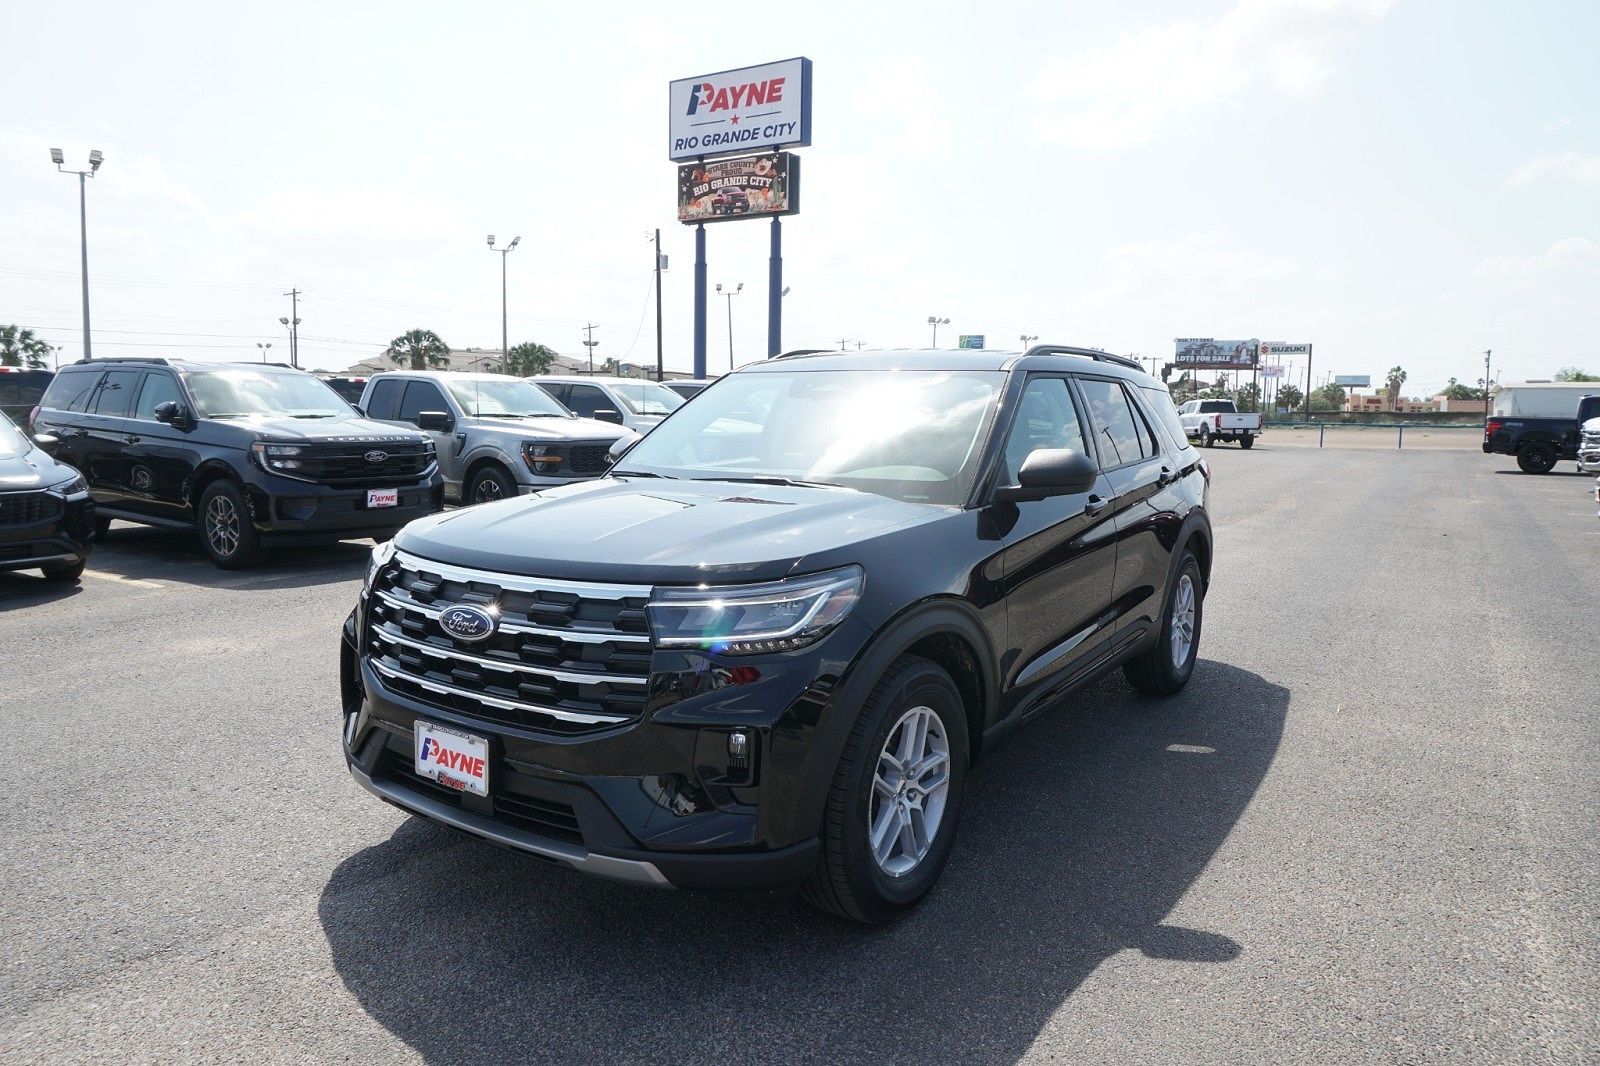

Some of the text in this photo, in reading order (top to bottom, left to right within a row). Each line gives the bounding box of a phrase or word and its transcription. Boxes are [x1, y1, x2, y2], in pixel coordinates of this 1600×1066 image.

[686, 77, 786, 116] PAYNE
[674, 121, 797, 151] RIO GRANDE CITY
[729, 160, 756, 169] COUNTY
[693, 176, 772, 196] RIO GRANDE CITY
[369, 495, 396, 503] PAYNE
[449, 611, 478, 633] Ford
[420, 737, 486, 779] PAYNE
